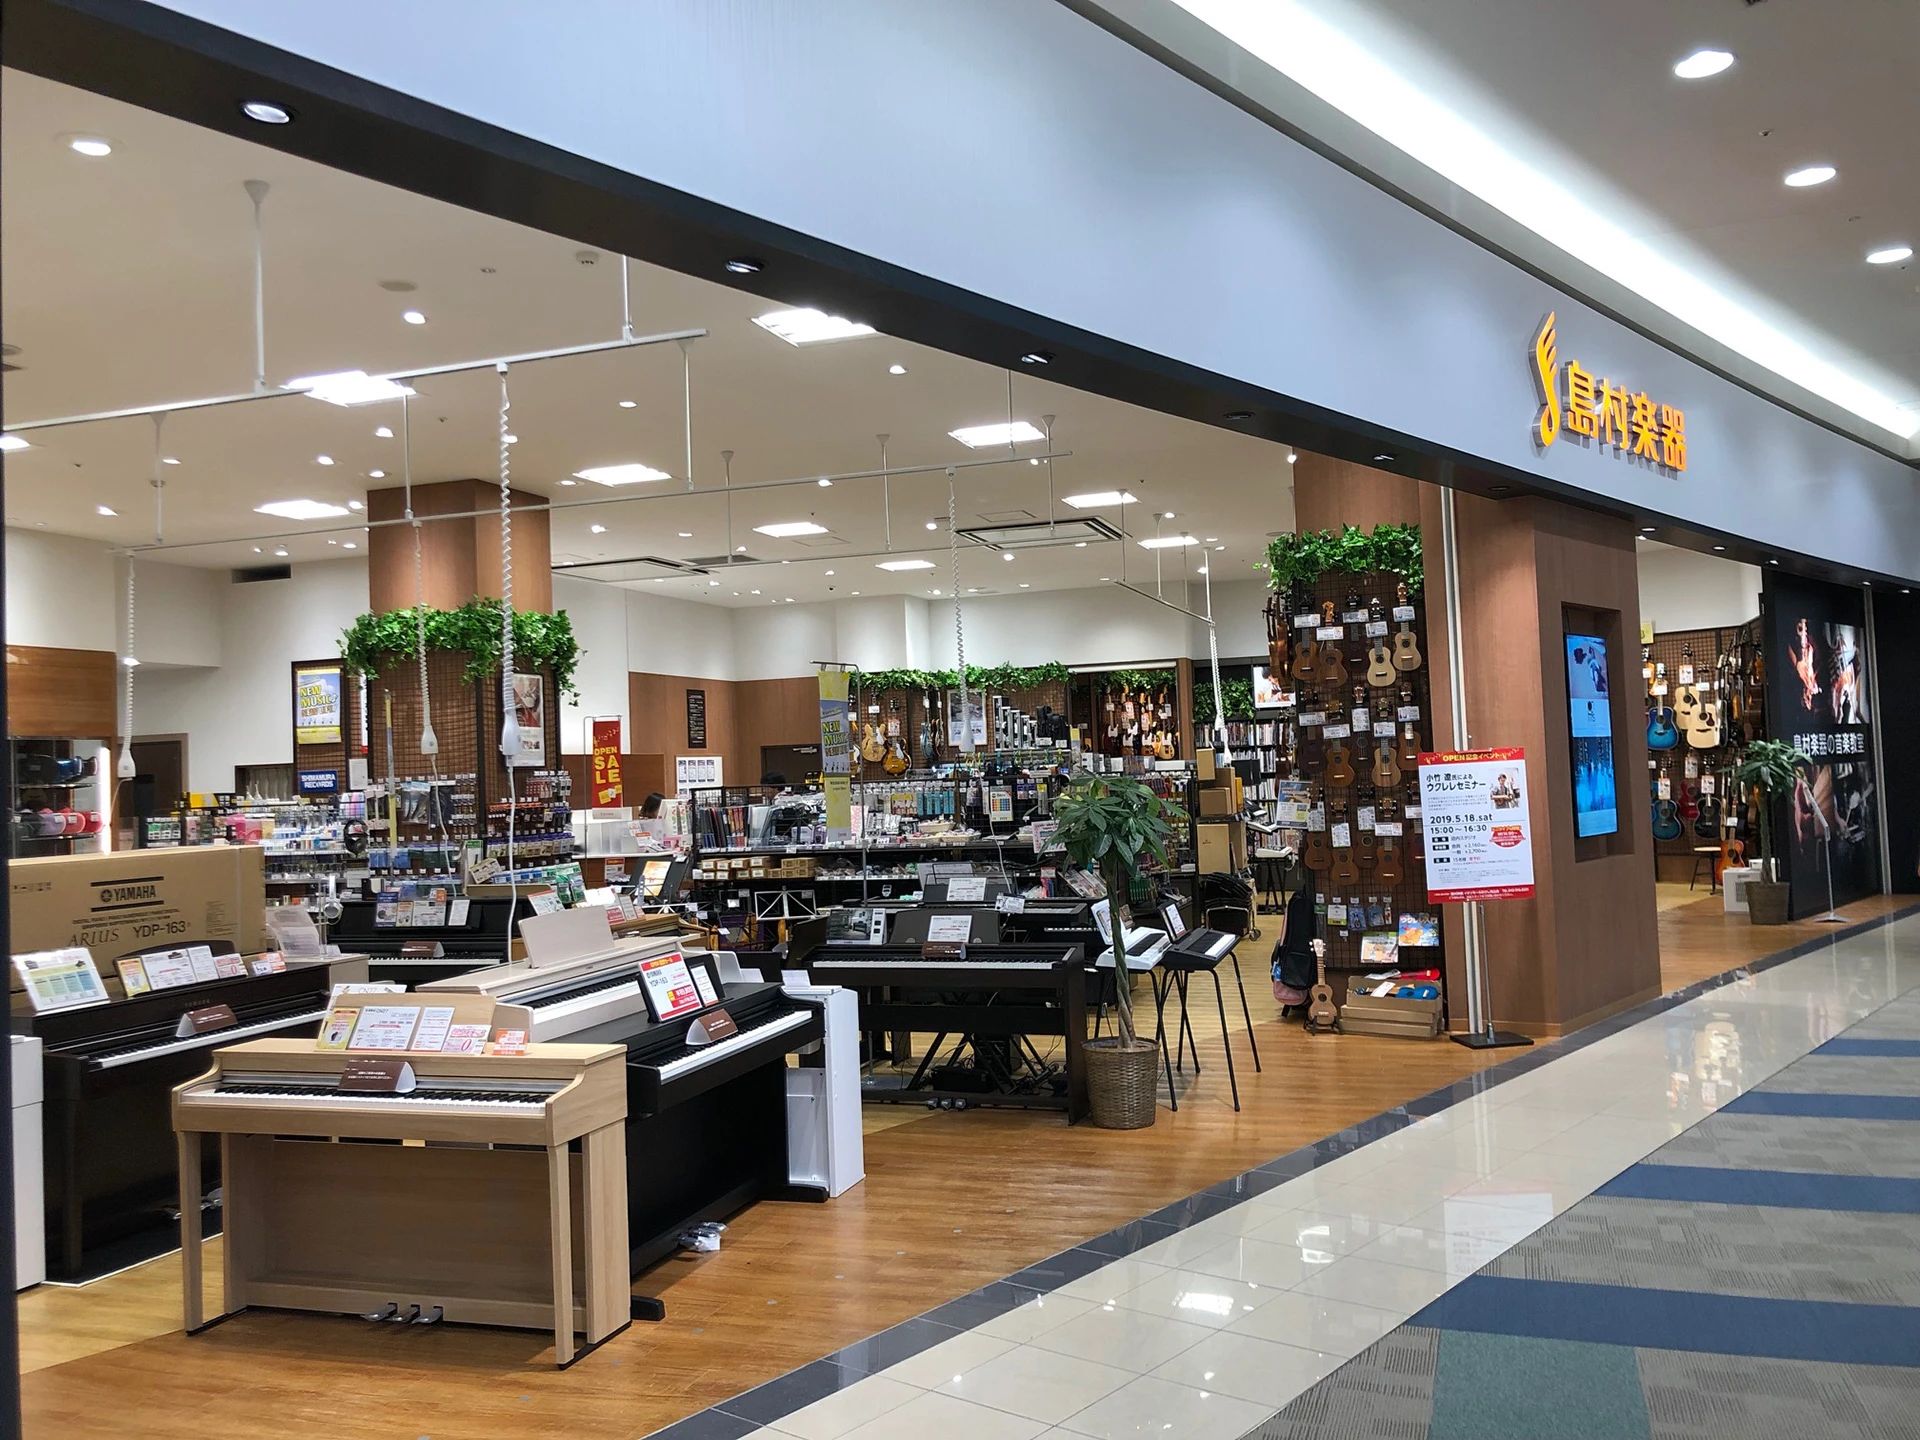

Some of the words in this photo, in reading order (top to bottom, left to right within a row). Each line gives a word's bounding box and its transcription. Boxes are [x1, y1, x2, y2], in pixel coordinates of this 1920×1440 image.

[1567, 360, 1687, 472] 島村楽器
[300, 685, 322, 698] NEW
[301, 694, 331, 708] MUSIC
[822, 720, 841, 733] NEW
[594, 746, 618, 756] OPEN
[301, 774, 336, 783] SHIMAMURA
[304, 781, 334, 789] RECORDS
[1427, 781, 1486, 792] ウクレレセミナー
[1430, 813, 1493, 824] 2019.5.18.sat
[114, 885, 156, 901] YAMAHA
[68, 928, 120, 947] ARIUS
[133, 920, 186, 938] YDP-163
